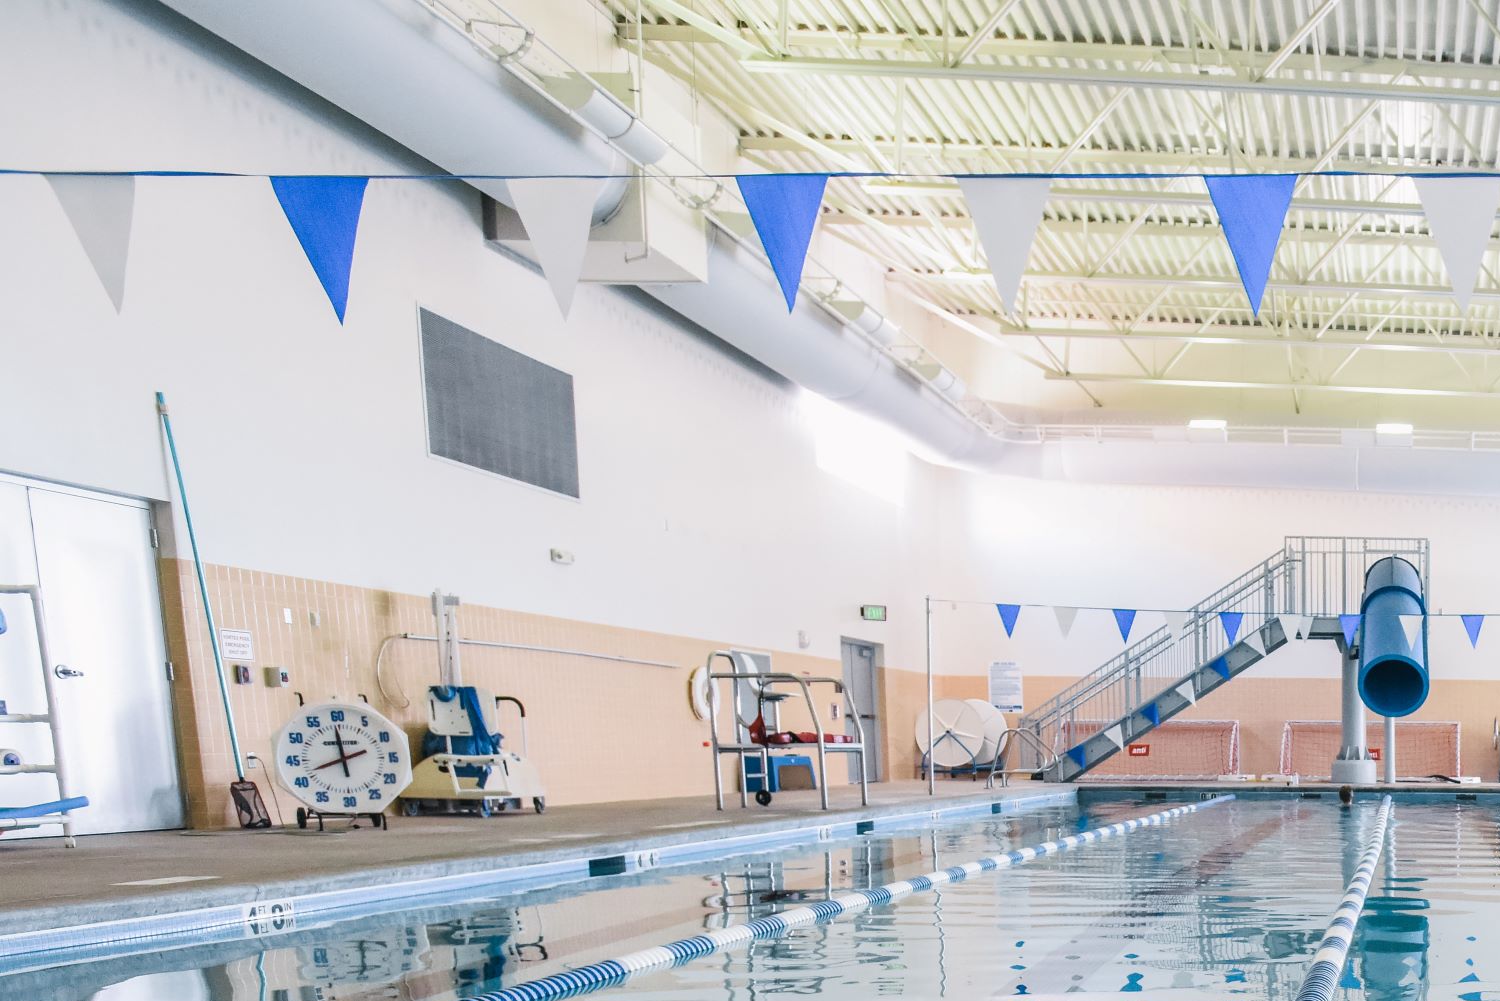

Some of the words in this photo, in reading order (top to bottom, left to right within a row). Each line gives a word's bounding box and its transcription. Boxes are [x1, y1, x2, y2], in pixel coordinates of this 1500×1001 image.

[306, 716, 321, 728] 55
[330, 710, 345, 722] 60
[361, 715, 369, 727] 5
[288, 732, 304, 744] 50
[379, 731, 390, 743] 10
[285, 755, 301, 767] 45
[388, 751, 399, 763] 15
[294, 776, 309, 788] 40
[384, 773, 397, 784] 20
[315, 791, 330, 803] 35
[368, 788, 382, 800] 25
[343, 796, 357, 808] 30
